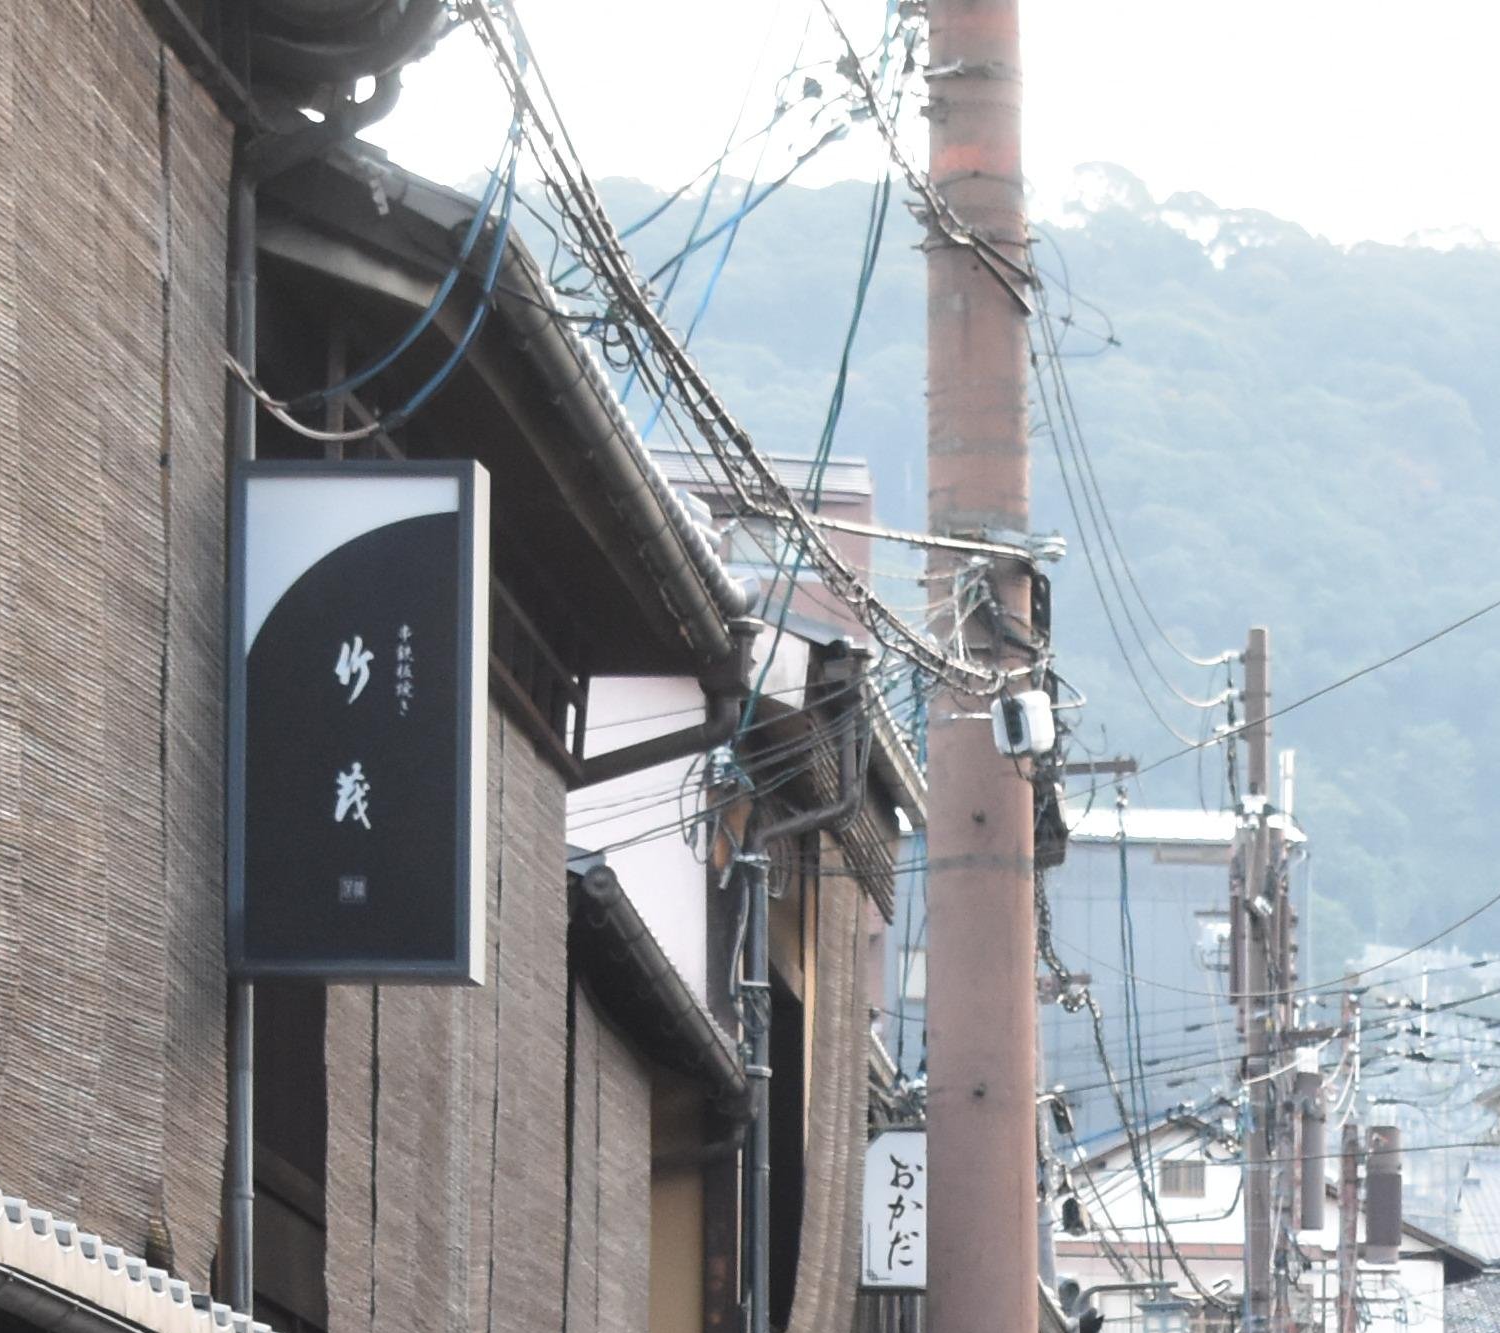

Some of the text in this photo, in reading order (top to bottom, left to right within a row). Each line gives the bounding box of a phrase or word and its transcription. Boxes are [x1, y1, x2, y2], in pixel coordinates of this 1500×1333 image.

[334, 633, 376, 831] 竹茂
[886, 1153, 924, 1272] おかだ
